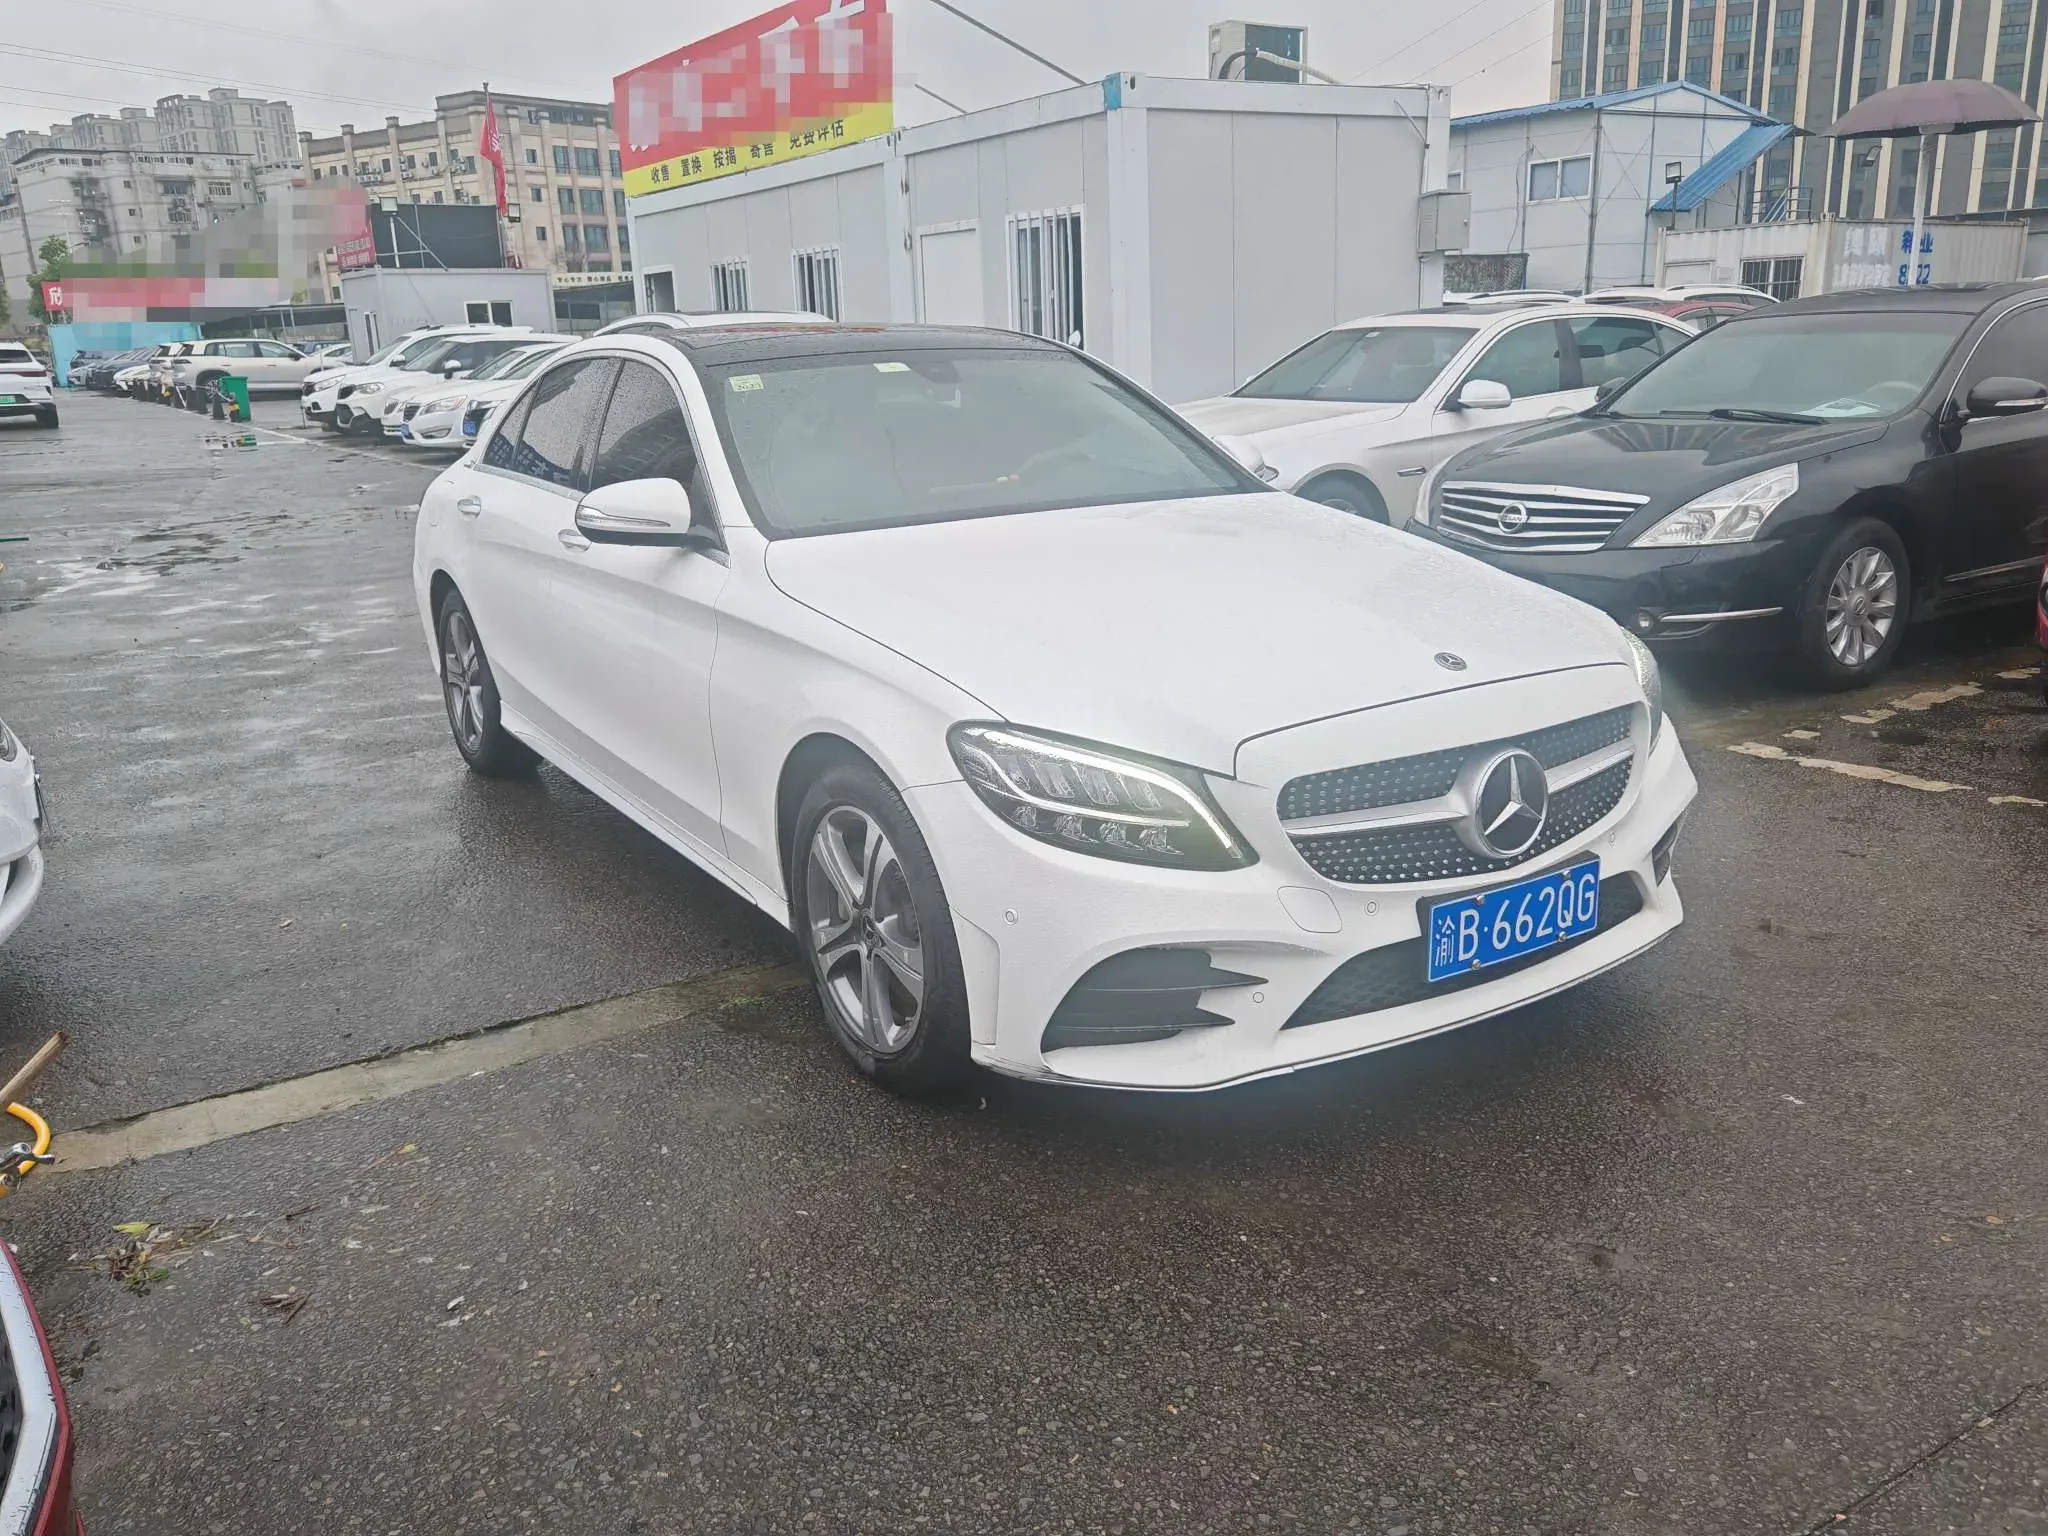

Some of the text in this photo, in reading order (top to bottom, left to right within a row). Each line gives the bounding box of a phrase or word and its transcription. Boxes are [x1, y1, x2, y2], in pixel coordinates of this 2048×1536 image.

[650, 163, 670, 185] 收售
[680, 156, 703, 178] 置换
[713, 146, 737, 169] 按揭
[1434, 872, 1597, 968] 渝B·662QG
